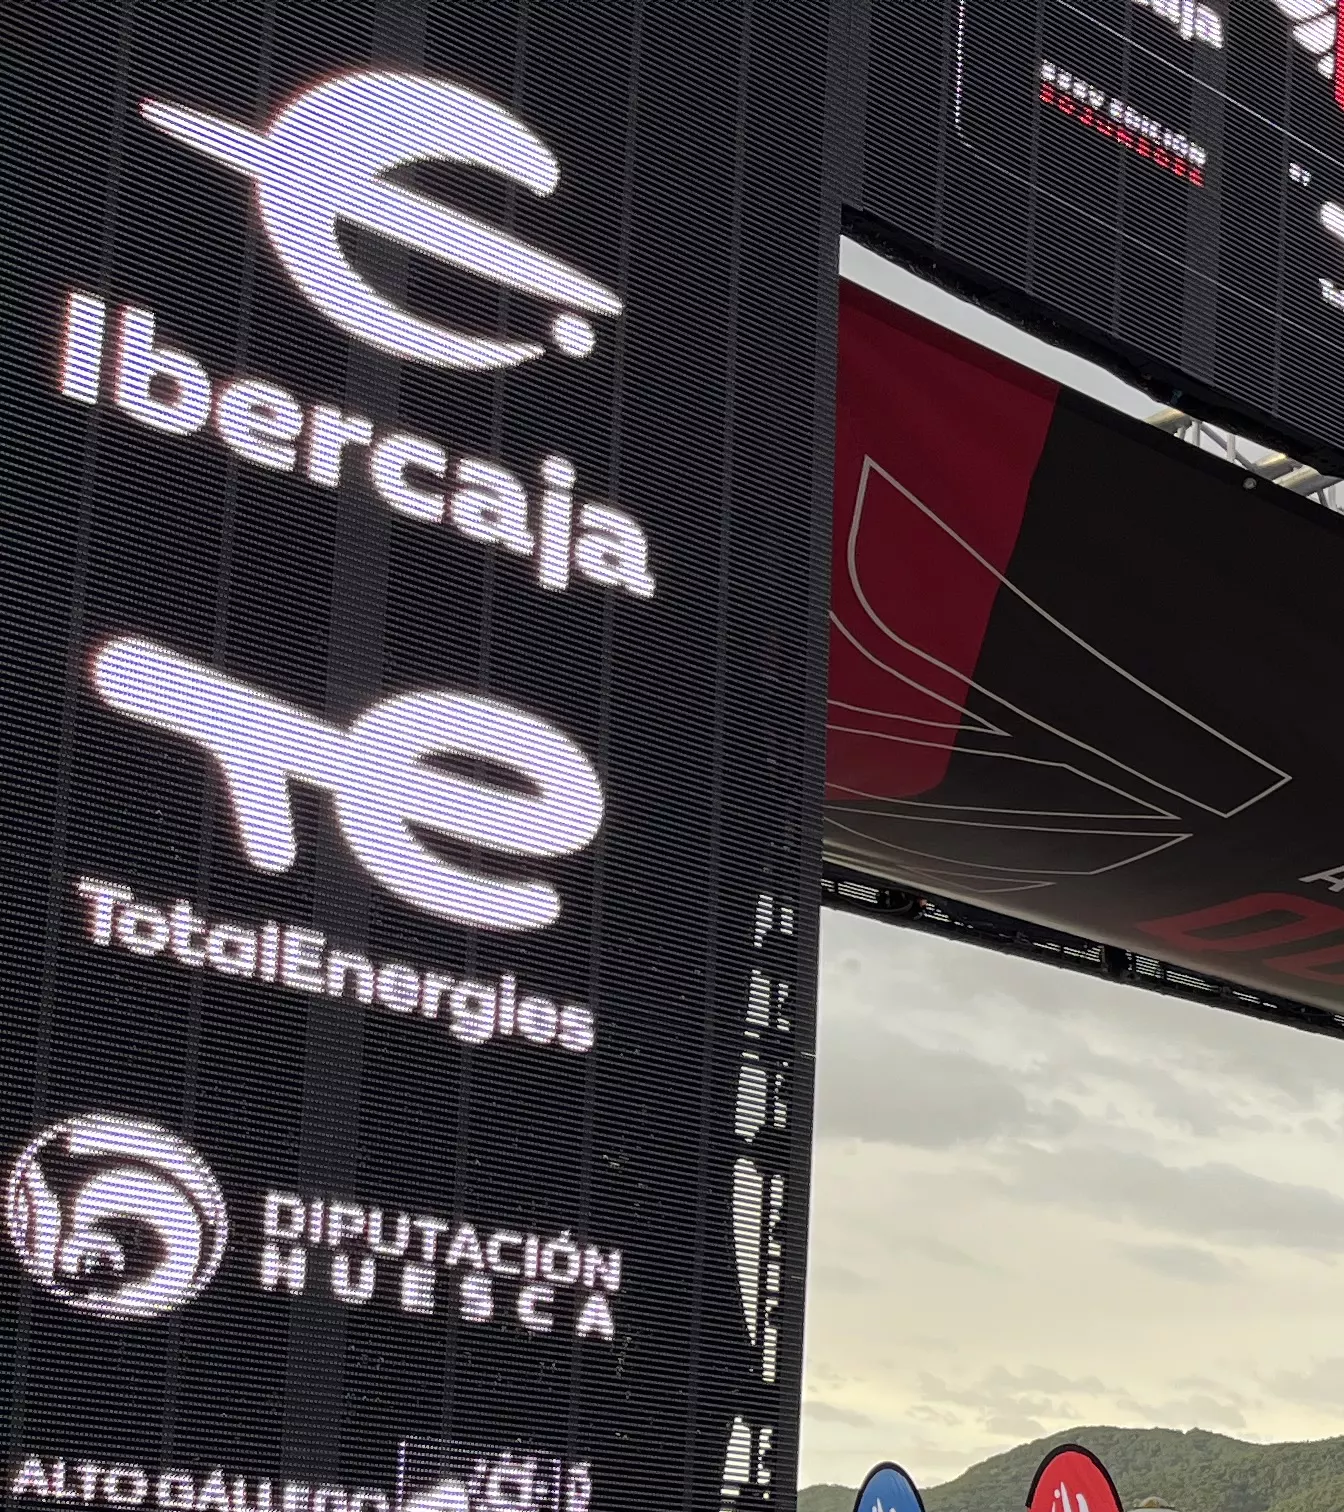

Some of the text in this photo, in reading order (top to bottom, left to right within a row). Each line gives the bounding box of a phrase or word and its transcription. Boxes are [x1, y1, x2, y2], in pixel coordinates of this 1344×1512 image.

[60, 291, 656, 598] Ibercaja
[78, 876, 596, 1055] TotalEnergies
[262, 1191, 624, 1294] DIPUTACIÓN
